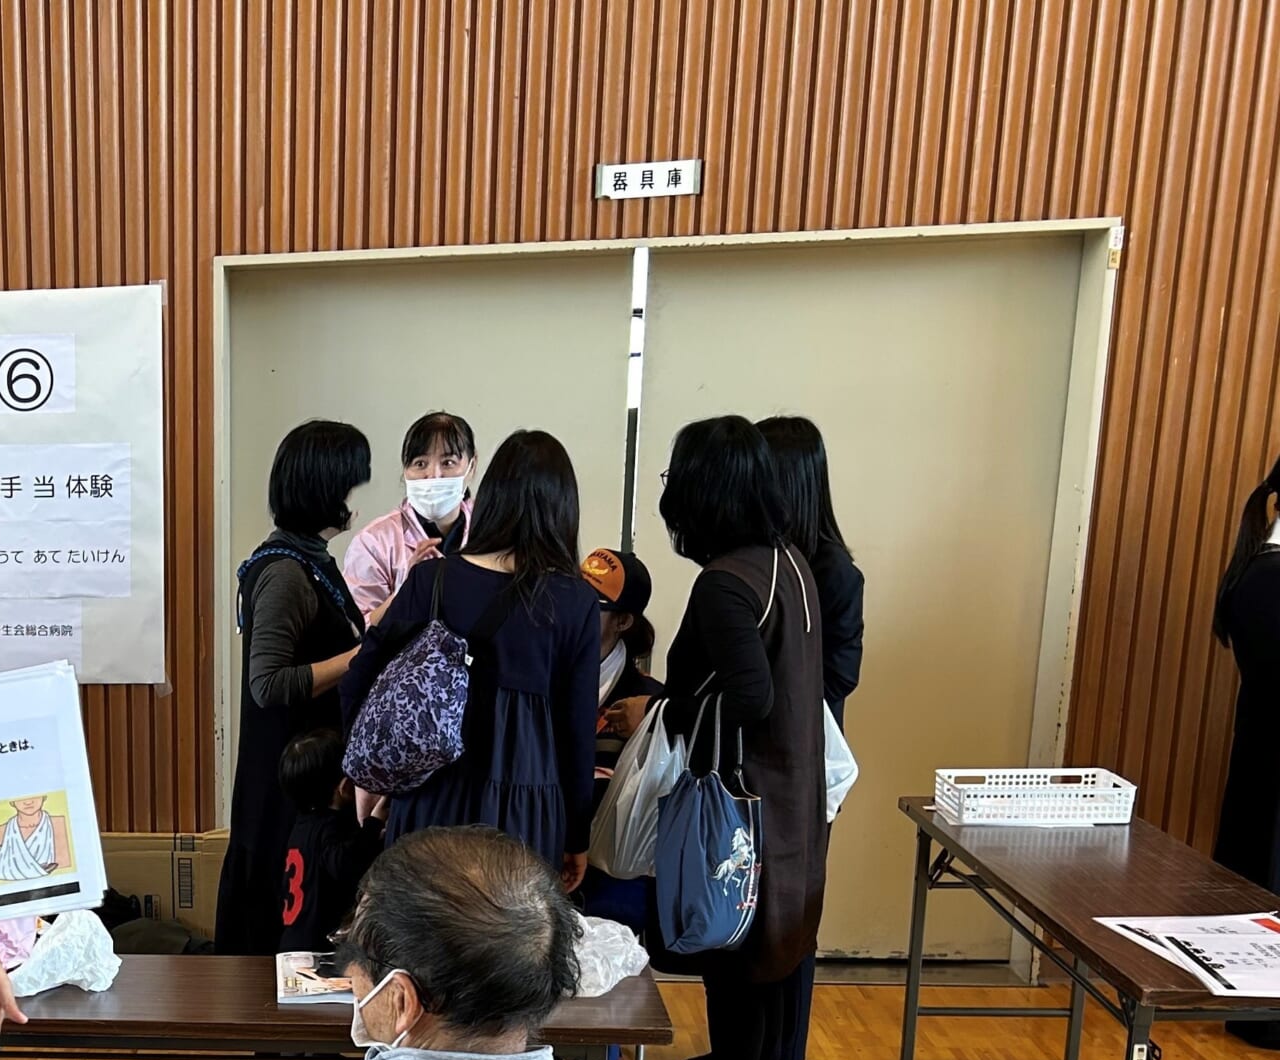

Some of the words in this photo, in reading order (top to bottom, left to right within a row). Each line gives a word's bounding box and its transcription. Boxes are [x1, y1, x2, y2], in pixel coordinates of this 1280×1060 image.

[612, 167, 683, 192] 器具庫
[283, 848, 304, 925] 3
